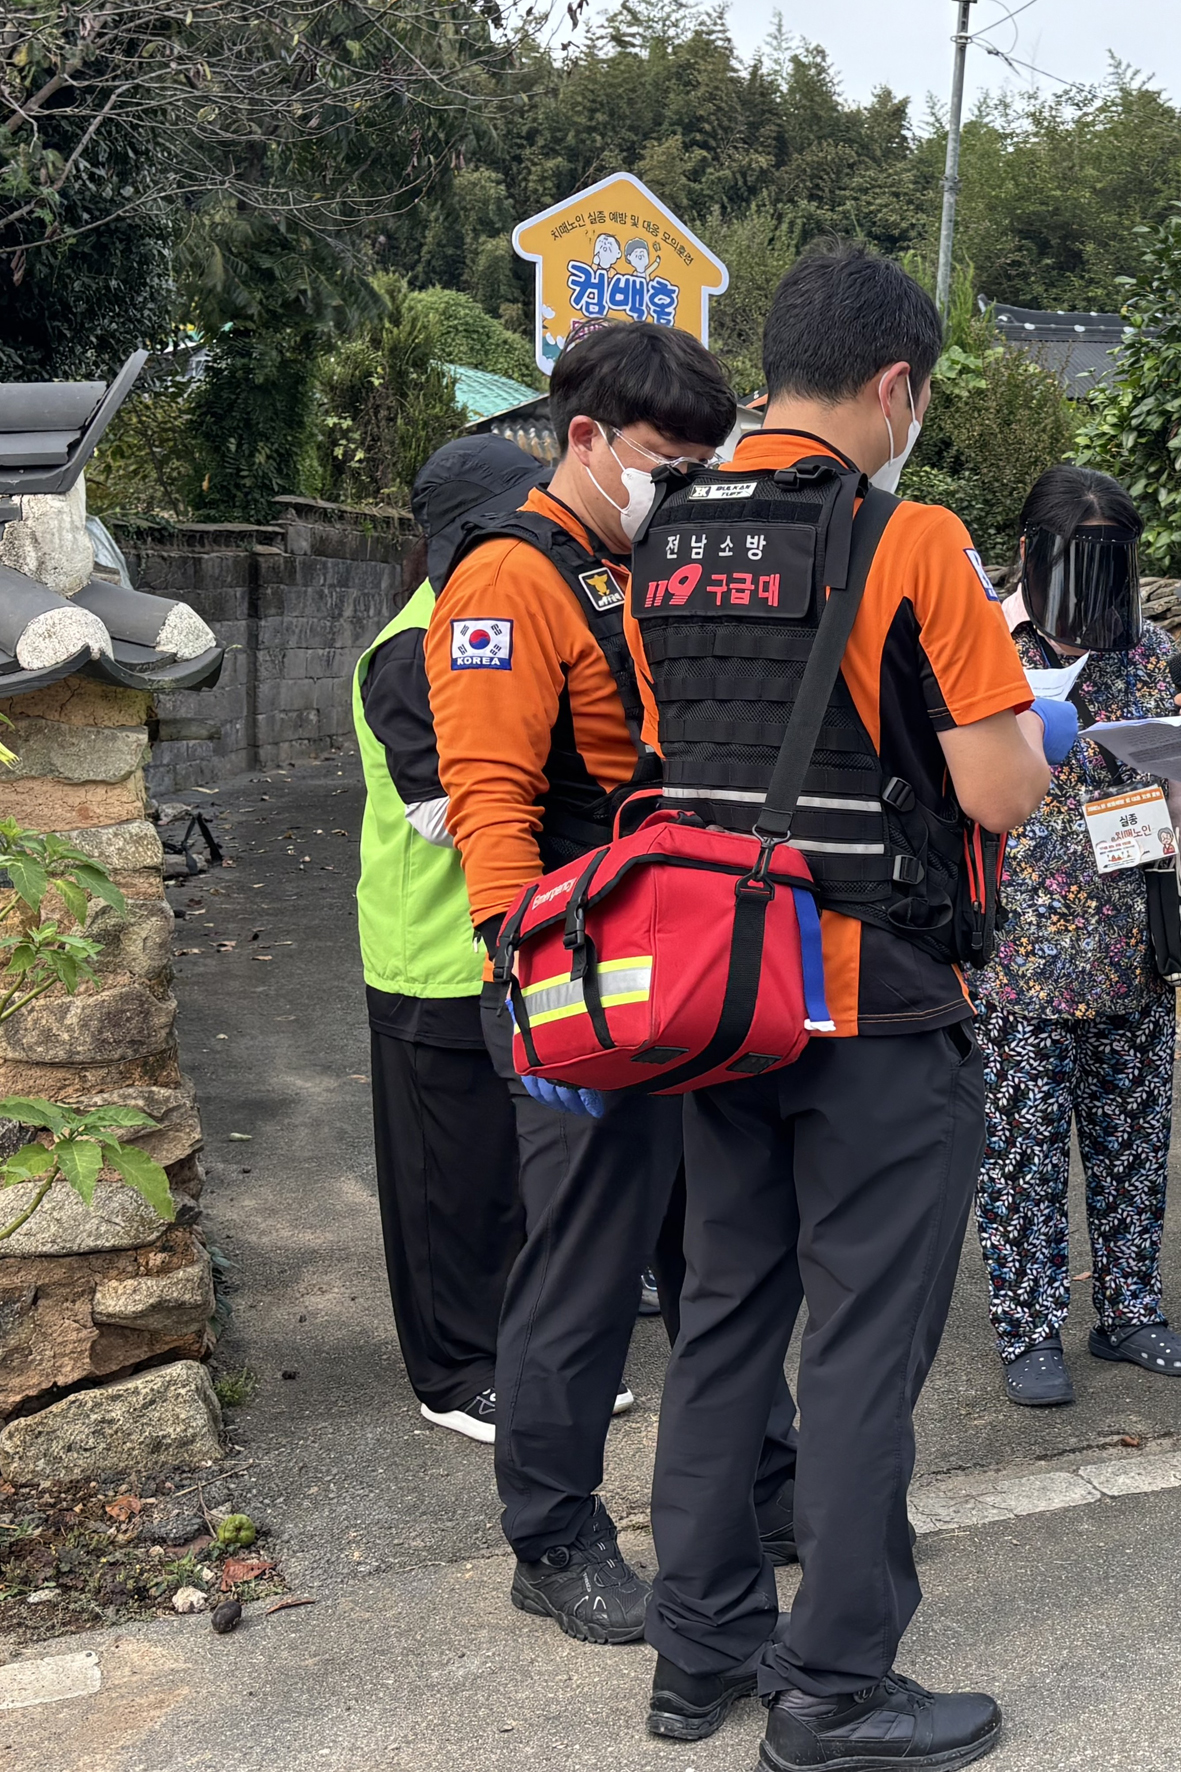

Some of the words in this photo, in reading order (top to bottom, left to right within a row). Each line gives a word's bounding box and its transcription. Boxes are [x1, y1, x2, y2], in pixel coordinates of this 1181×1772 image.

[551, 213, 586, 241] 치매노인
[587, 210, 606, 225] 실종
[608, 211, 628, 225] 예방
[630, 214, 639, 228] 및
[642, 219, 660, 237] 대응
[660, 231, 694, 266] 모의훈련
[568, 261, 678, 328] 컴백홈
[706, 572, 781, 607] 구급대
[457, 656, 501, 666] KOREA
[1119, 812, 1138, 828] 실종
[531, 876, 578, 910] Emergency
